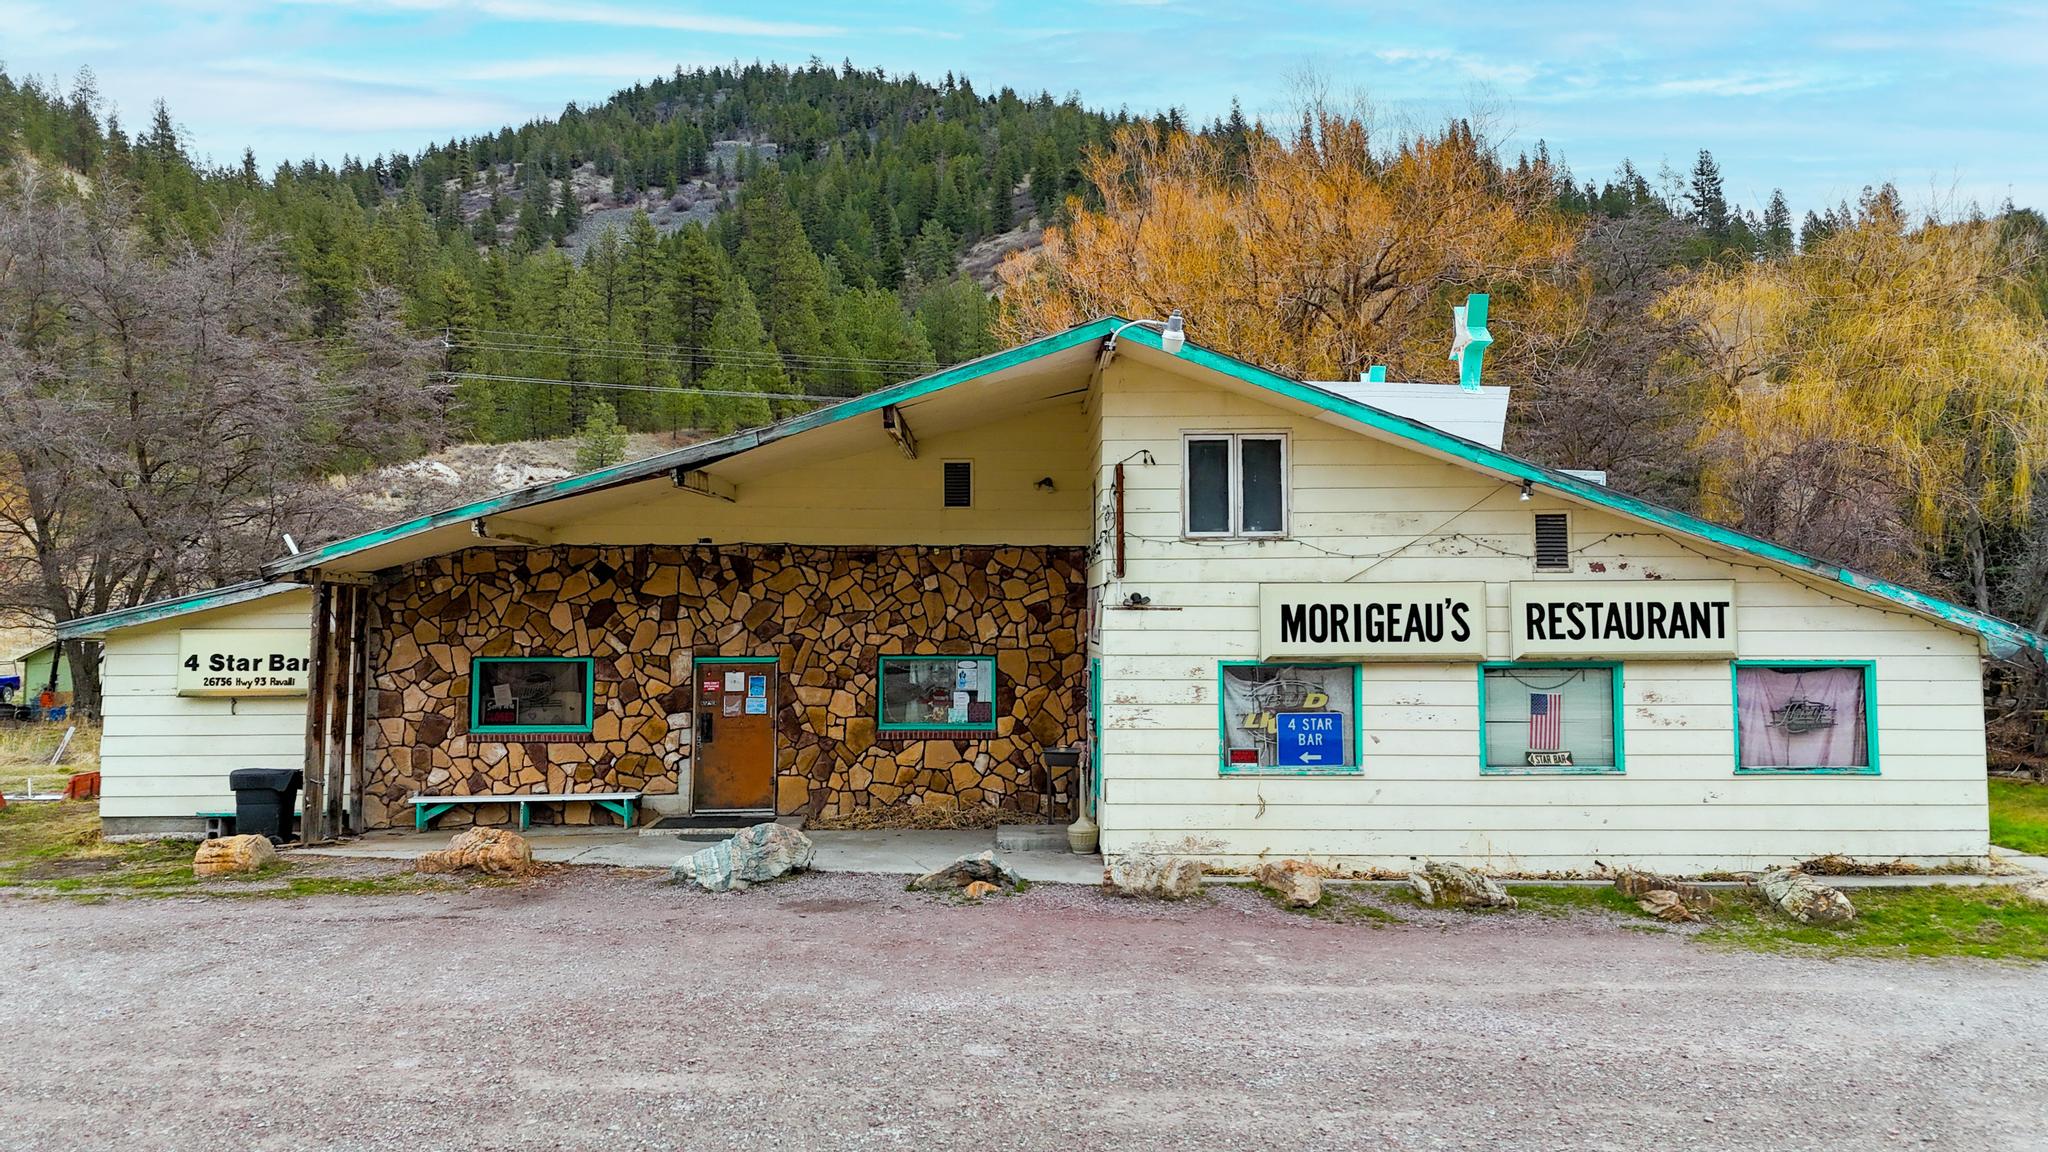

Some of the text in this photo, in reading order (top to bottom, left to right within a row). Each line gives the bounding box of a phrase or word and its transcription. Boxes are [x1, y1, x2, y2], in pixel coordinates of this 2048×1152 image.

[1280, 597, 1730, 644] MORIGEAU'S RESTAURANT
[184, 653, 308, 672] 4 Star Bar
[235, 677, 254, 690] Hwy
[254, 677, 267, 687] 93
[270, 677, 296, 687] Ravalli
[1288, 718, 1332, 731] 4 STAR
[1298, 733, 1323, 746] BAR
[1535, 754, 1552, 764] STAR
[1553, 754, 1567, 764] BAR
